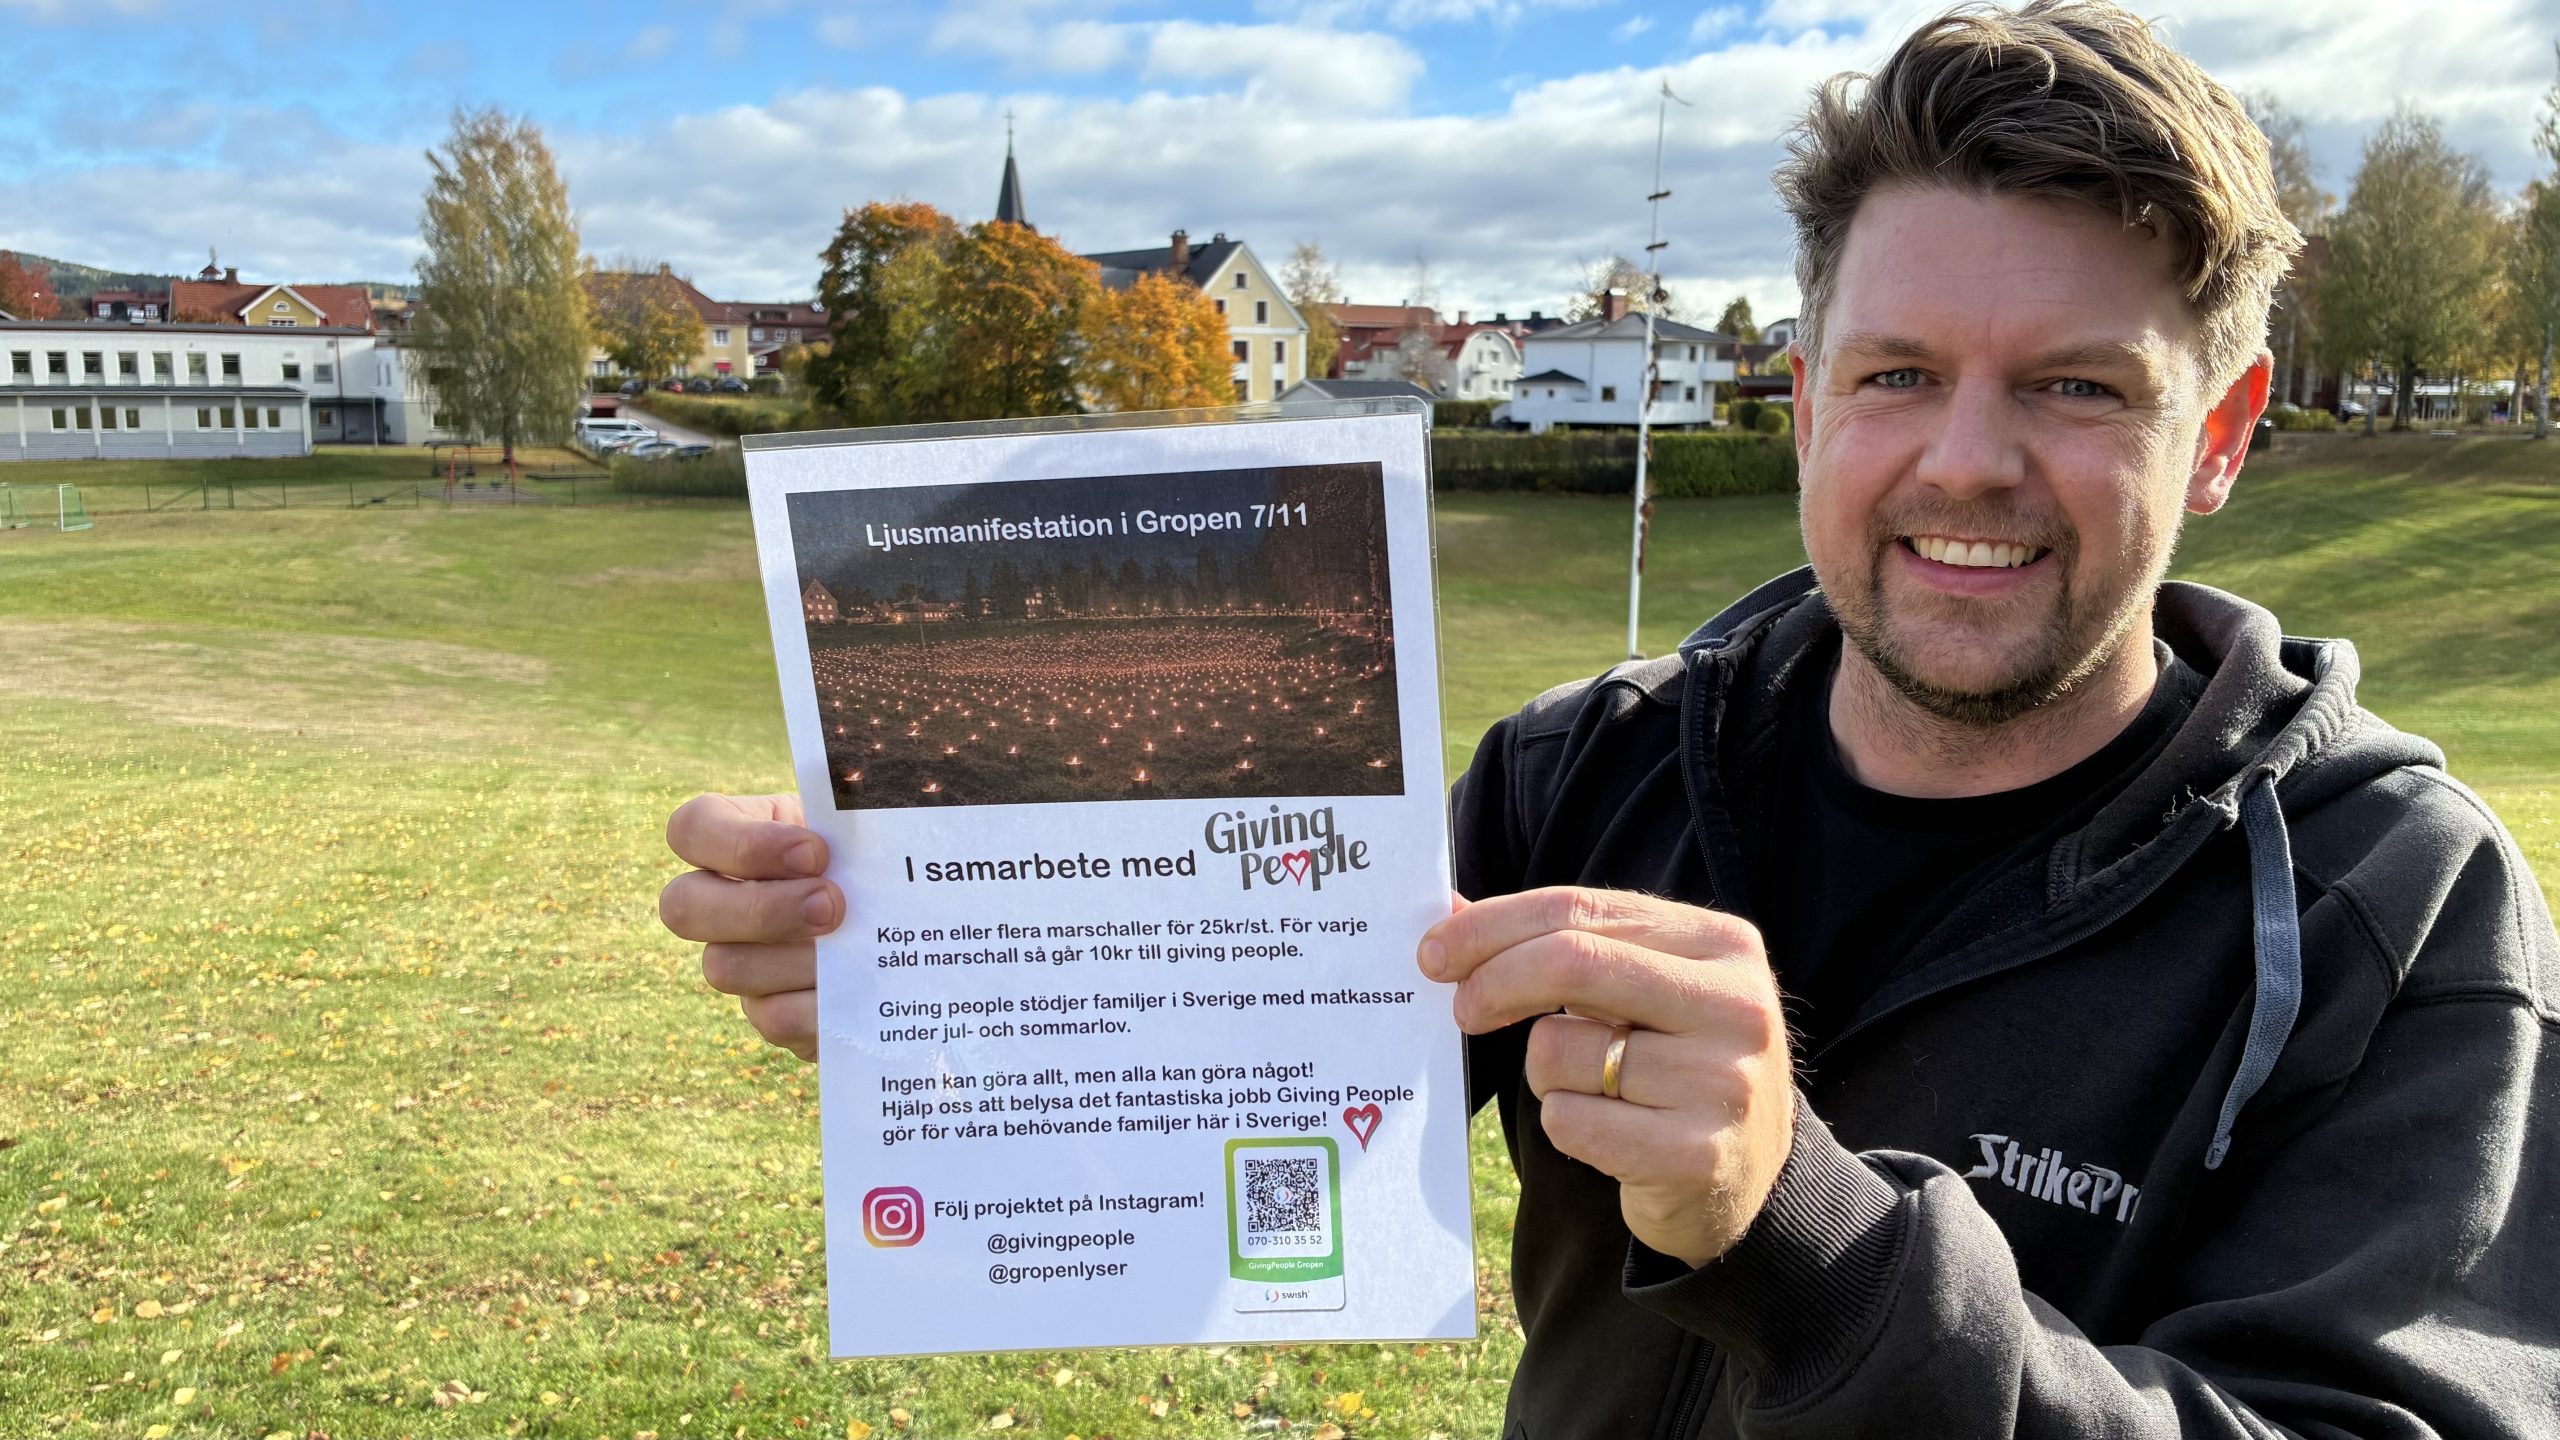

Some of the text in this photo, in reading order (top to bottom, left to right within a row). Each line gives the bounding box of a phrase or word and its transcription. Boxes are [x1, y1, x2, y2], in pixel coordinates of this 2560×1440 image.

[866, 502, 1306, 551] Ljusmanifestation i Gropen 7/11
[1204, 804, 1336, 858] Giving
[906, 849, 1196, 882] I samarbete med
[878, 917, 1367, 946] Köp en eller flera marschaller för 25kr/st. För varje
[878, 942, 1303, 968] såld marschall så går 10kr till giving people.
[879, 989, 1415, 1019] Giving people stödjer familjer i Sverige med matkassar
[880, 1018, 1131, 1043] under jul- och sommarlov.
[882, 1062, 1313, 1095] Ingen kan göra allt, men alla kan göra något!
[883, 1085, 1413, 1120] Hjälp oss att belysa det fantastiska jobb Giving People
[883, 1111, 1327, 1146] gör för våra behövande familjer här i Sverige!
[1962, 1133, 2144, 1224] StrikePr
[935, 1192, 1204, 1220] Följ projektet på Instagram!
[988, 1229, 1134, 1254] @givingpeople
[1247, 1235, 1323, 1246] 070-310 35 52
[989, 1261, 1128, 1284] @gropenlyser
[1297, 1261, 1324, 1270] Gropen
[1281, 1290, 1308, 1299] swish
